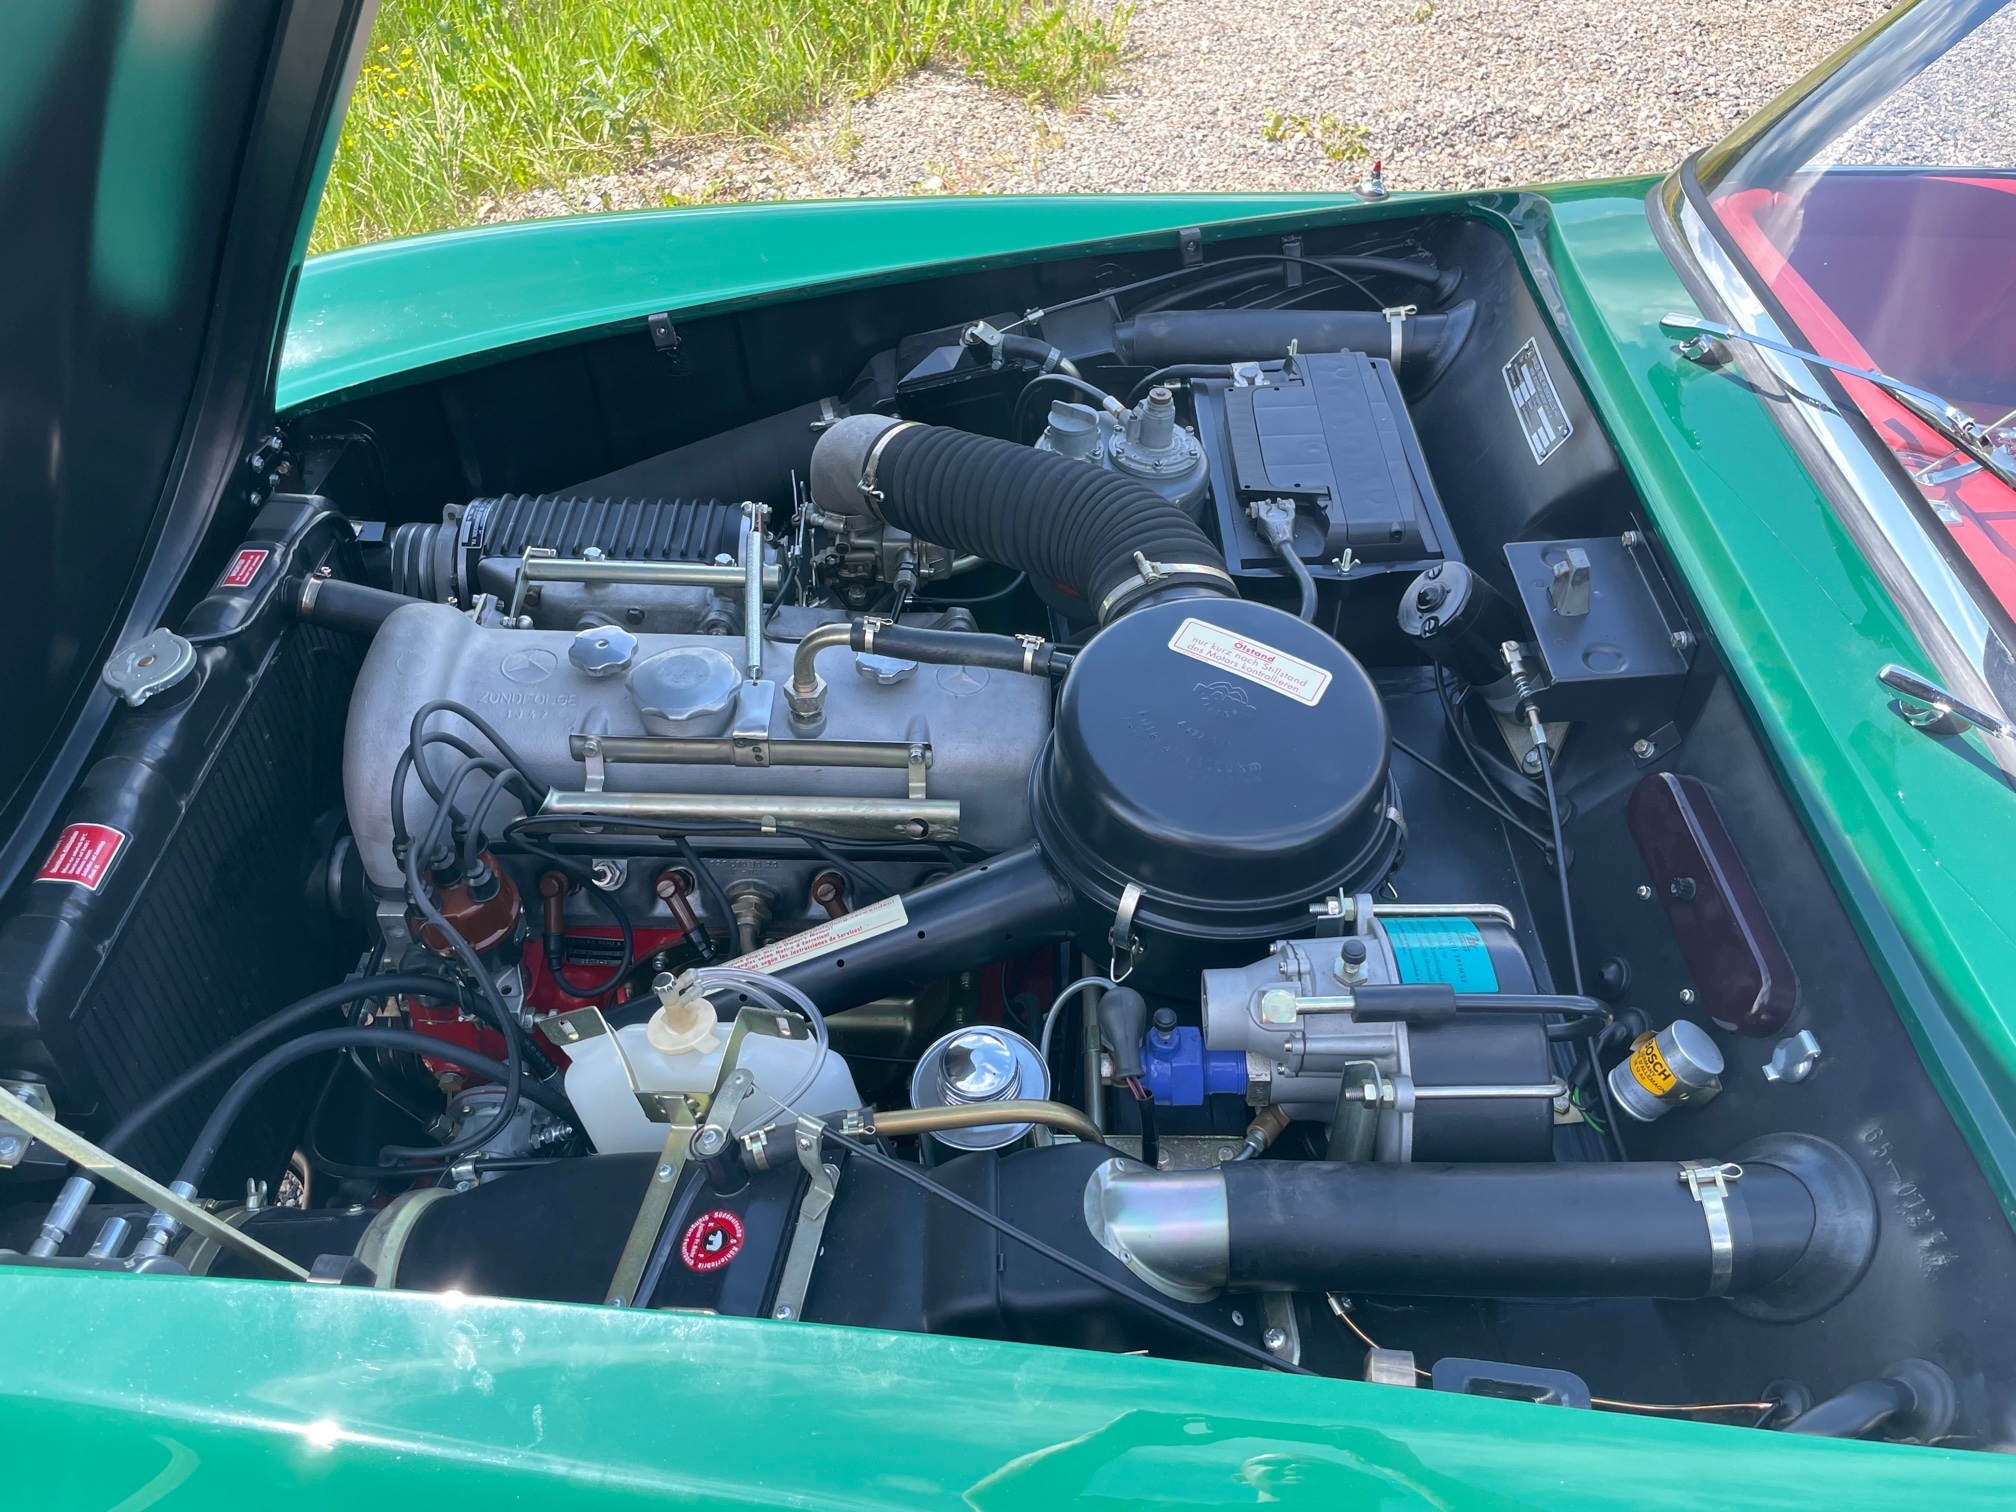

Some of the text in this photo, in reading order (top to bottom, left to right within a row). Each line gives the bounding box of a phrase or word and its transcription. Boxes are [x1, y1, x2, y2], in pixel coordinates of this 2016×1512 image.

[1187, 644, 1204, 654] des
[1206, 650, 1238, 668] Motors
[1192, 637, 1209, 646] nur
[1211, 643, 1232, 656] kurz
[1234, 653, 1259, 667] nach
[1262, 663, 1308, 687] Stillstand
[1234, 640, 1276, 663] Ölstand
[1454, 955, 1468, 984] BREMSE
[1645, 1039, 1672, 1081] BOSCH
